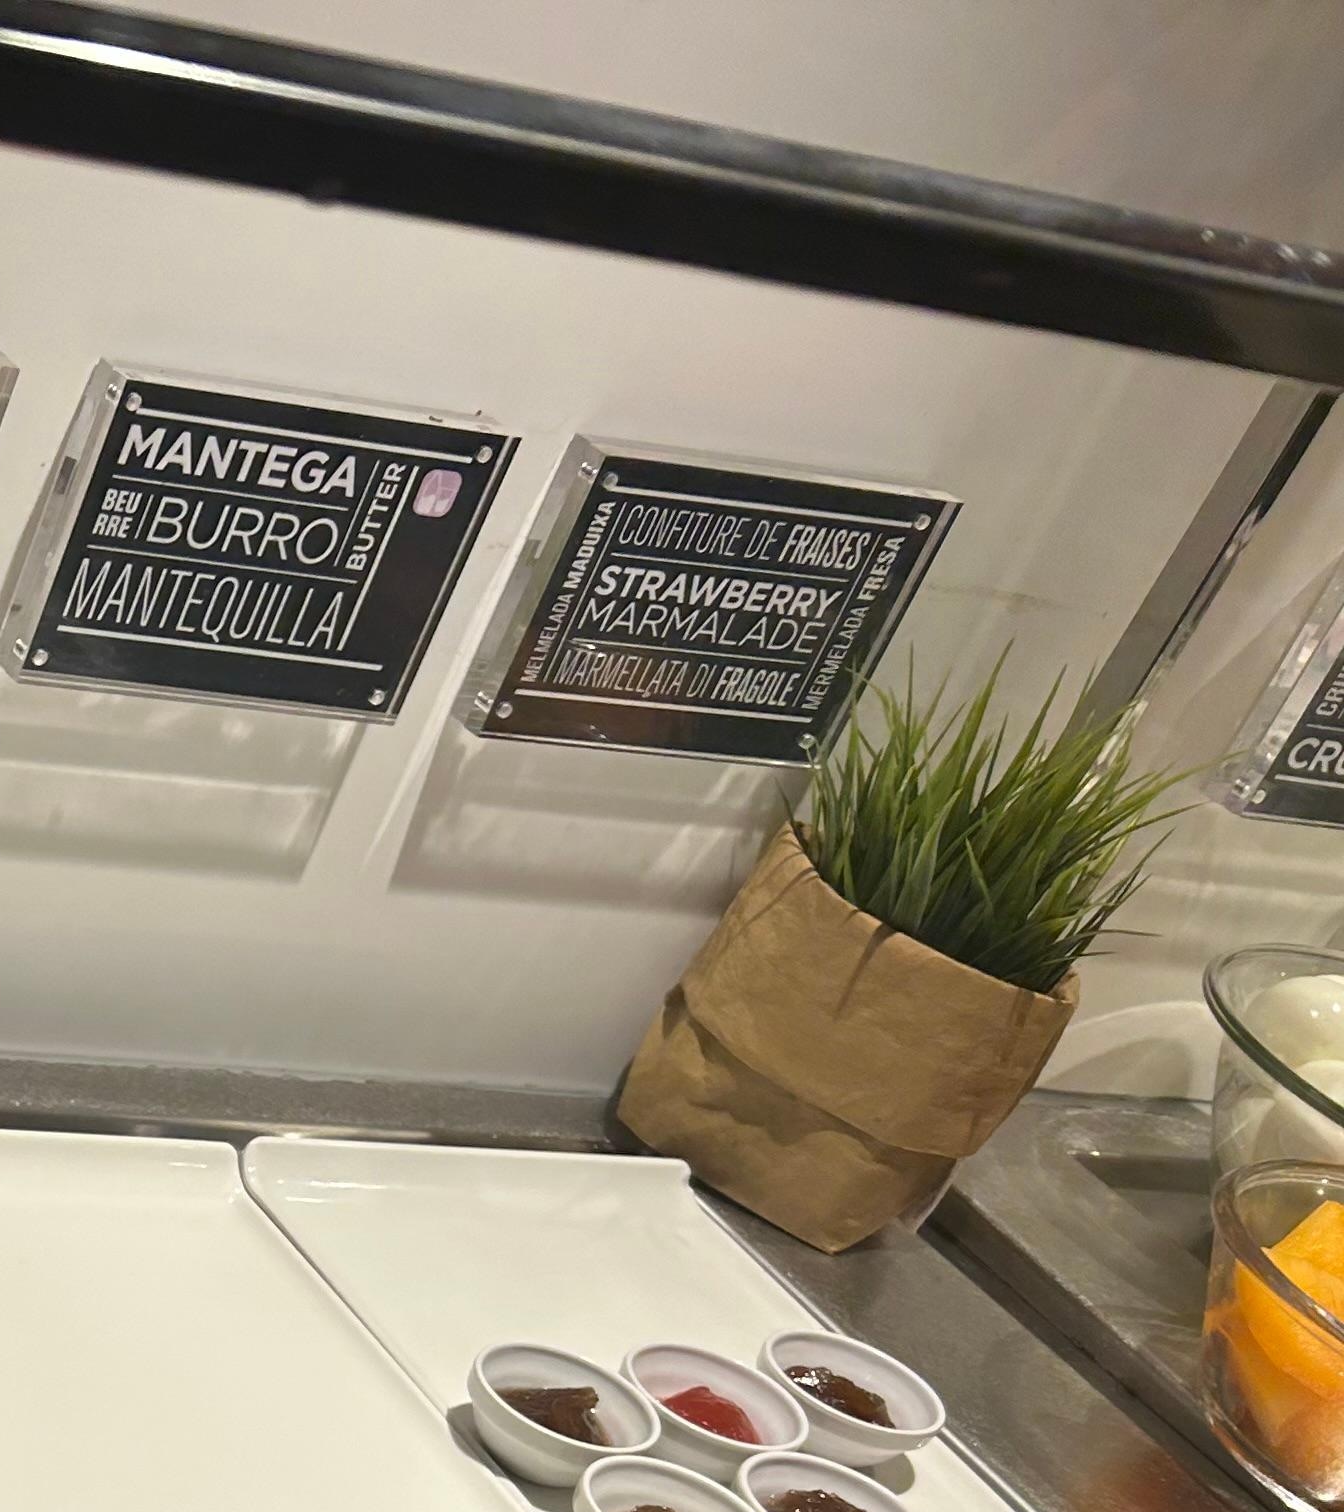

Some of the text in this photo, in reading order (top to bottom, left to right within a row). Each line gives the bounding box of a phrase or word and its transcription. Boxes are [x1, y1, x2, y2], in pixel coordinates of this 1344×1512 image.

[117, 424, 357, 498] MANTEGA
[92, 514, 134, 539] RRE
[101, 488, 140, 514] BEU
[147, 496, 338, 565] BURRO
[344, 462, 406, 572] BUTTER
[619, 505, 871, 571] CONFITURE DE FRAISES
[62, 557, 344, 651] MANTEQUILLA
[520, 501, 617, 684] MELMELADA MADUIXA
[577, 597, 828, 655] MARMALADE
[595, 565, 843, 620] STRAWBERRY
[800, 536, 906, 711] MERMELADA FRESA
[554, 650, 801, 708] MARMELLATA DI FRAGOLE
